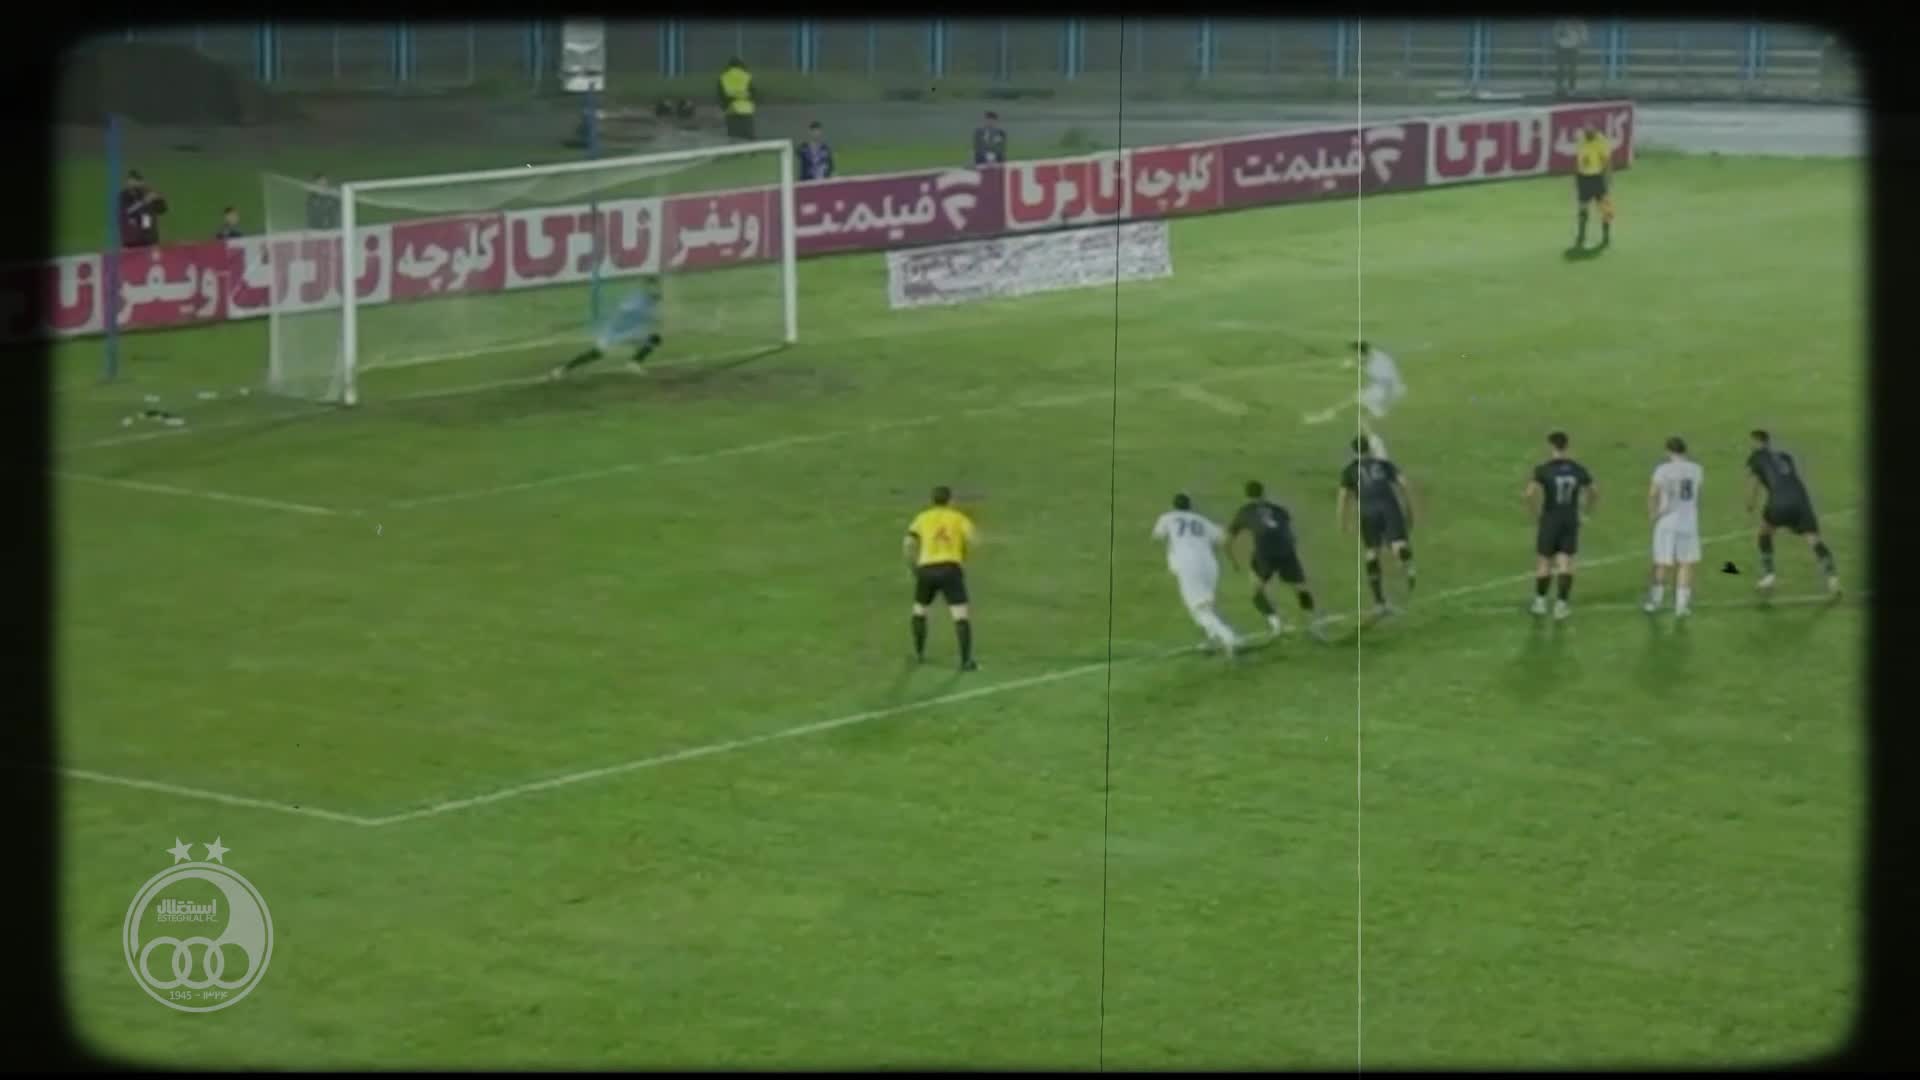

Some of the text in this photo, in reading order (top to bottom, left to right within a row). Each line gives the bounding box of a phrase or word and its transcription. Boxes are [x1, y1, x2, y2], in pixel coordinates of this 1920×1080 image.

[1135, 152, 1214, 211] کلوچه
[396, 221, 499, 291] کلوچه
[670, 200, 761, 266] ویفر
[116, 250, 218, 325] ویفر
